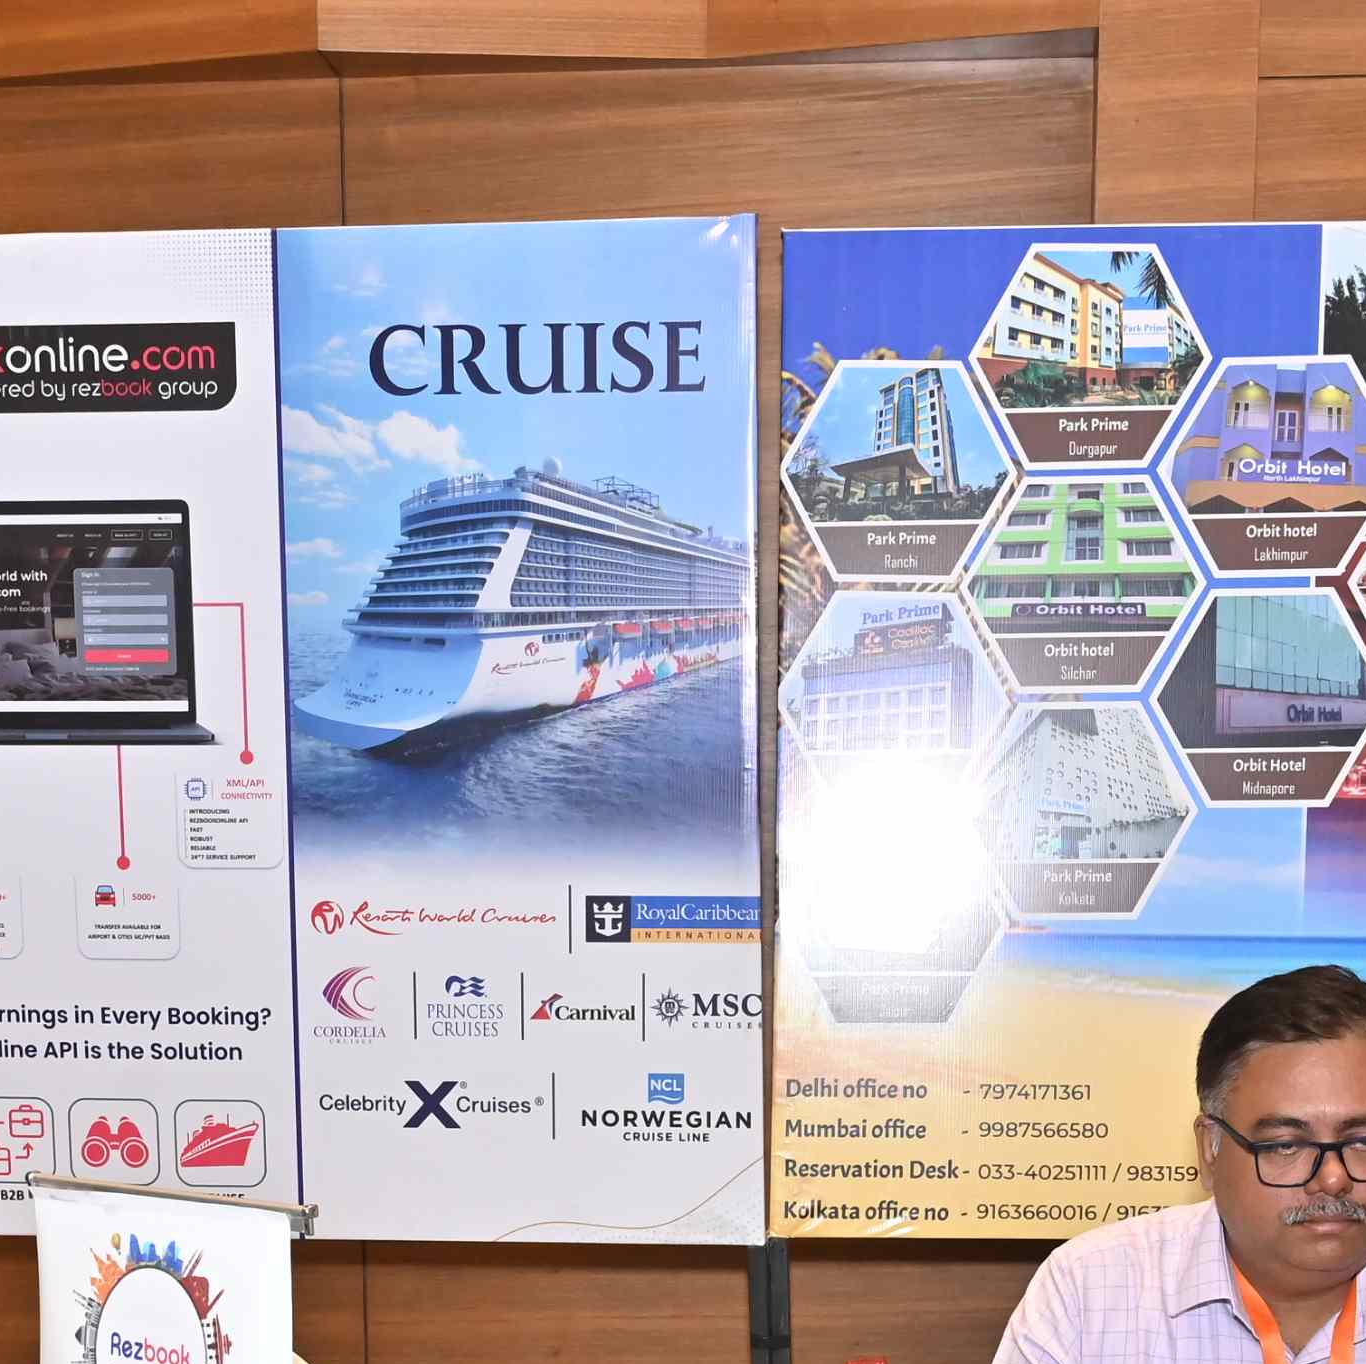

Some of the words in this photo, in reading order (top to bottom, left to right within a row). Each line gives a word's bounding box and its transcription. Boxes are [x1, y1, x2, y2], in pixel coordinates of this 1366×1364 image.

[369, 319, 706, 396] CRUISE
[40, 379, 66, 401] by
[71, 377, 153, 398] rezbook
[158, 378, 219, 400] group
[1059, 418, 1087, 432] Park
[1090, 417, 1129, 433] Prime
[1069, 440, 1117, 458] Durgapur
[1239, 459, 1287, 473] Orbit
[1298, 460, 1346, 476] Hotel
[867, 532, 894, 546] Park
[898, 532, 936, 546] Prime
[1246, 524, 1280, 538] Orbit
[1284, 523, 1317, 537] hotel
[884, 553, 918, 569] Ranchi
[1254, 547, 1308, 564] Lakhimpur
[20, 569, 48, 581] with
[1035, 603, 1084, 616] Orbit
[1089, 603, 1144, 616] Hotel
[1044, 644, 1077, 658] Orbit
[1081, 643, 1115, 657] hotel
[1061, 664, 1096, 681] Silchar
[1233, 759, 1269, 773] Orbit
[1273, 759, 1306, 773] Hotel
[1242, 780, 1295, 798] Midnapore
[1043, 870, 1071, 882] Park
[1075, 869, 1112, 882] Prime
[637, 931, 761, 940] INTERNATIONA
[427, 1003, 504, 1020] PRINCESS
[556, 1004, 636, 1022] Carnival
[692, 993, 763, 1017] MSC
[74, 1006, 94, 1024] in
[100, 1007, 161, 1030] Every
[168, 1007, 271, 1031] Booking?
[314, 1026, 386, 1038] CORDELIA
[432, 1020, 499, 1038] CRUISES
[44, 1041, 78, 1058] API
[84, 1041, 101, 1059] is
[107, 1042, 144, 1060] the
[150, 1042, 243, 1061] Solution
[650, 1078, 682, 1092] NCL
[786, 1079, 838, 1099] Delhi
[843, 1079, 899, 1099] office
[903, 1084, 927, 1099] no
[979, 1084, 1091, 1101] 7974171361
[319, 1094, 406, 1117] Celebrity
[456, 1095, 531, 1114] Cruises
[581, 1109, 752, 1130] NORWEGIAN
[623, 1132, 673, 1142] CRUISE
[679, 1132, 710, 1143] LINE
[785, 1119, 867, 1139] Mumbai
[871, 1119, 927, 1140] office
[979, 1122, 1109, 1139] 9987566580
[784, 1159, 904, 1179] Reservation
[978, 1163, 1107, 1182] 033-40251111
[1127, 1165, 1198, 1182] 983159
[0, 1190, 25, 1200] B2B
[784, 1201, 860, 1221] Kolkata
[865, 1201, 920, 1221] office
[924, 1206, 948, 1221] no
[976, 1203, 1096, 1220] 9163660016
